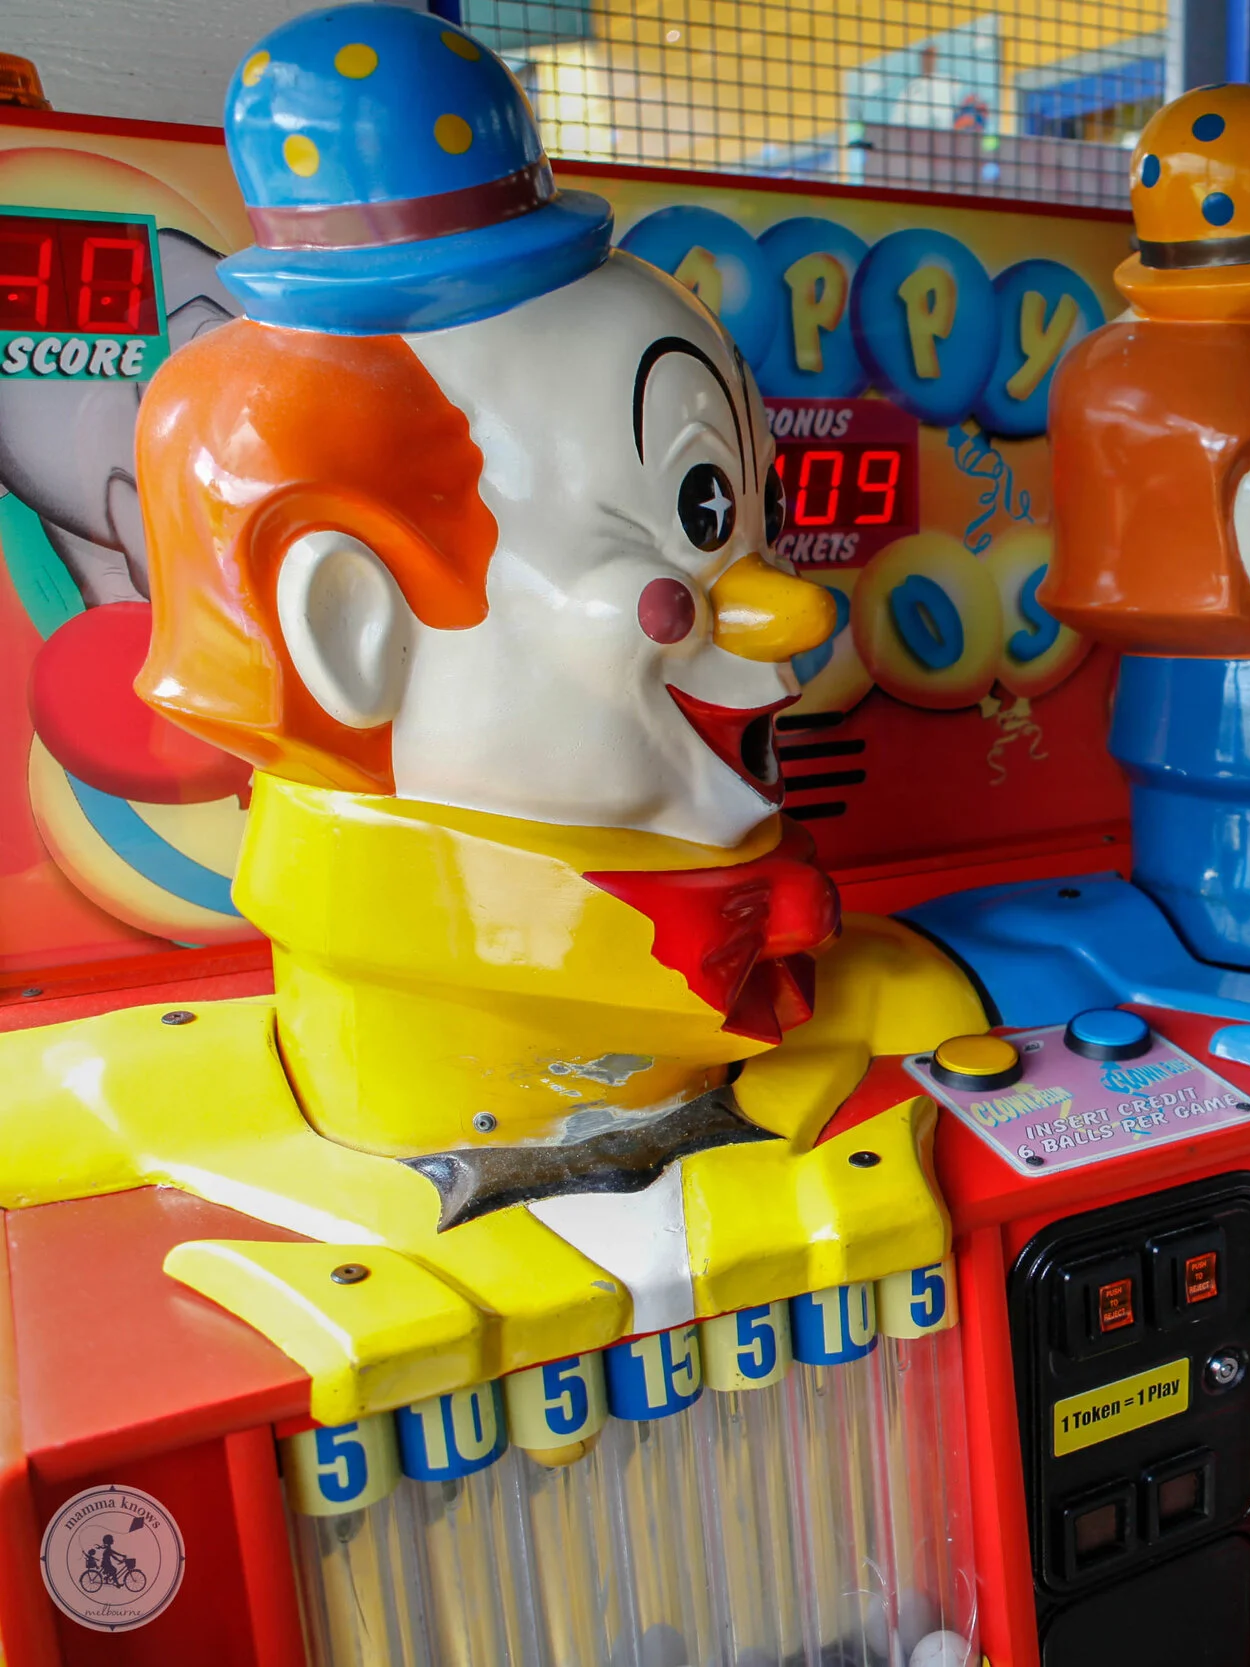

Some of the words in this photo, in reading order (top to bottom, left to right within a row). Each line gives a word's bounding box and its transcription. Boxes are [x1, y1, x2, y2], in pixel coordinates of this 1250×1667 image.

[2, 336, 147, 377] SCORE
[777, 531, 859, 563] CKETS
[1017, 1144, 1036, 1160] 6
[1040, 1124, 1114, 1153] BALLS
[1121, 1112, 1169, 1133] PER
[1174, 1093, 1239, 1119] GAME
[1026, 1108, 1110, 1140] INSERT
[1117, 1087, 1198, 1116] CREDIT
[1106, 1286, 1122, 1298] PUSH
[1189, 1281, 1210, 1294] REJECT
[1191, 1260, 1207, 1271] PUSH
[1195, 1272, 1203, 1280] TO
[811, 1281, 876, 1354] 10
[910, 1263, 946, 1328] 5
[1104, 1307, 1125, 1321] REJECT
[1110, 1299, 1119, 1307] TO
[630, 1324, 701, 1409] 15
[736, 1303, 777, 1379] 5
[541, 1356, 589, 1436] 5
[1061, 1415, 1069, 1433] 1
[1073, 1400, 1121, 1429] Token
[1137, 1388, 1145, 1405] 1
[1148, 1379, 1180, 1403] Play
[410, 1380, 498, 1470] 10
[314, 1421, 368, 1503] 5
